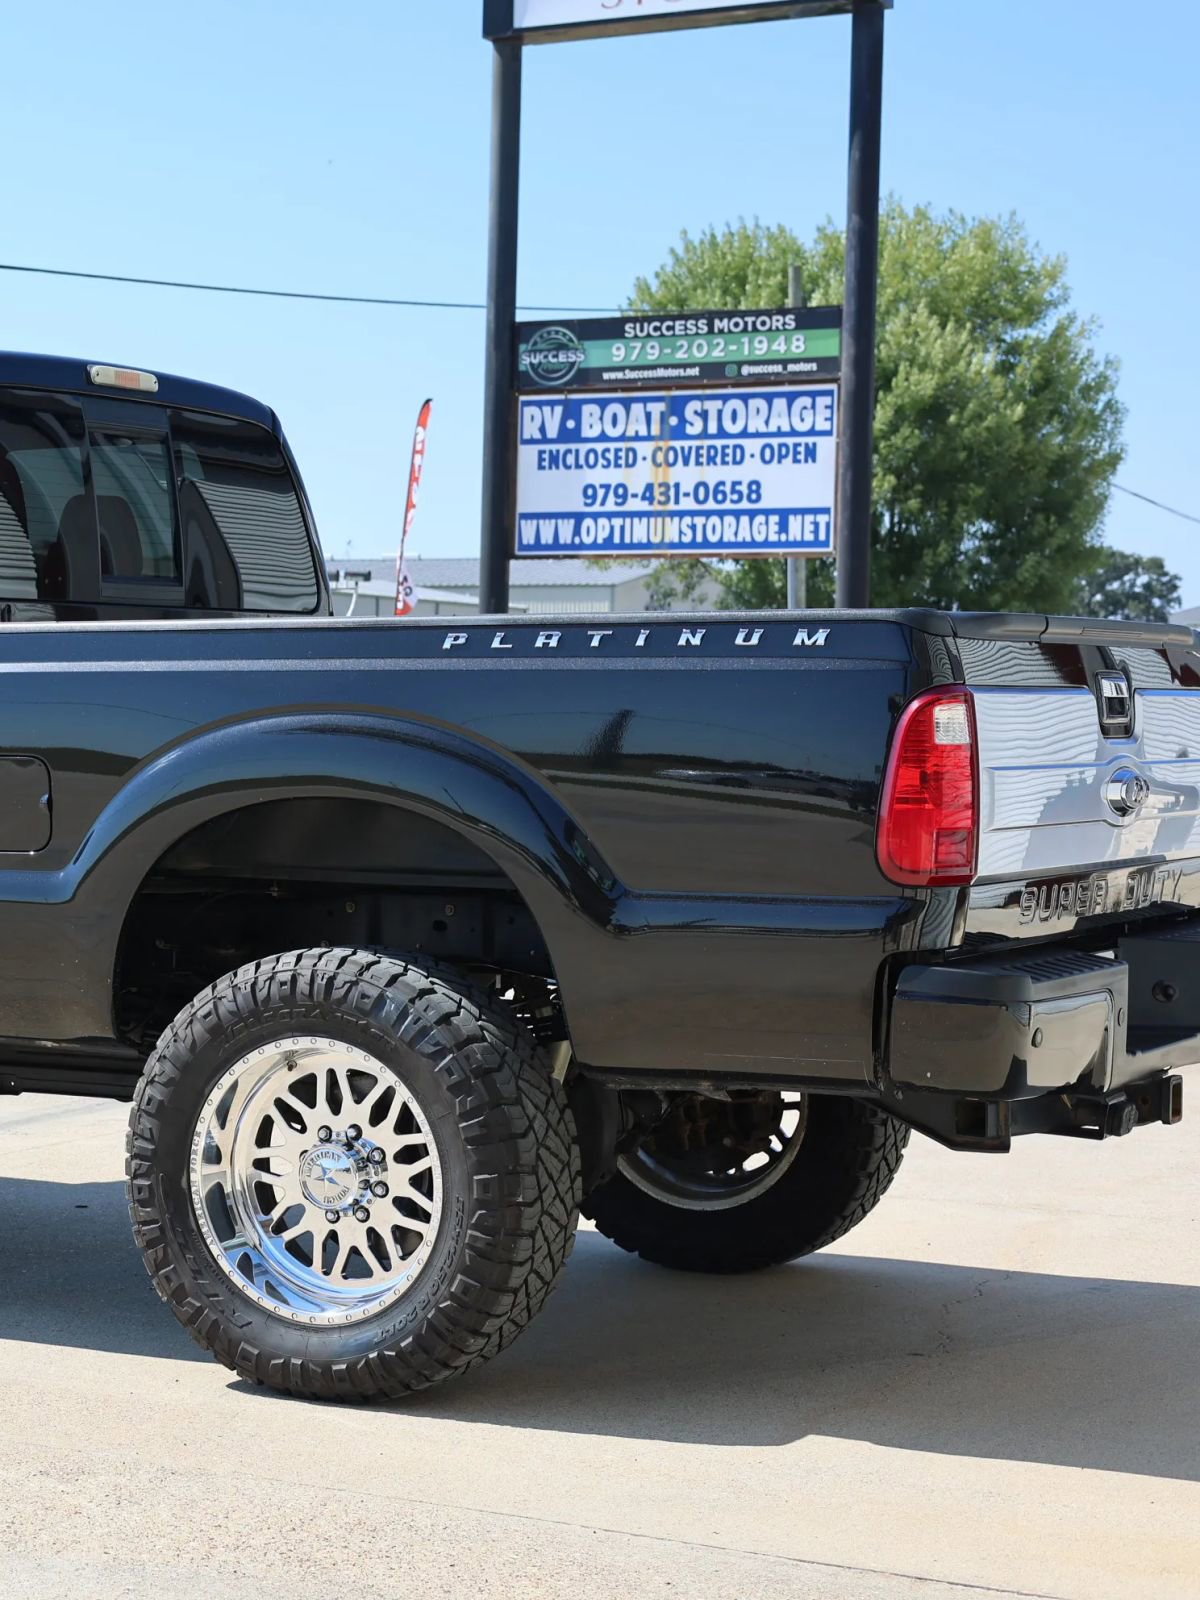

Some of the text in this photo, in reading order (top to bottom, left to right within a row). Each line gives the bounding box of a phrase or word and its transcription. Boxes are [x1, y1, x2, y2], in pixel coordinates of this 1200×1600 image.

[624, 315, 796, 338] SUCCESS MOTORS
[521, 349, 585, 365] SUCCESS
[611, 335, 806, 362] 979-202-1948
[741, 362, 818, 377] @success_motors
[522, 396, 833, 440] RV BOAT STORAGE
[537, 442, 818, 471] ENCLOSED COVERED OPEN
[582, 480, 763, 507] 979-431-0658
[520, 515, 830, 546] WWW.OPTIMUMSTORAGE.NET
[442, 628, 831, 650] PLATINUM
[1019, 867, 1183, 926] SUPER DUTY
